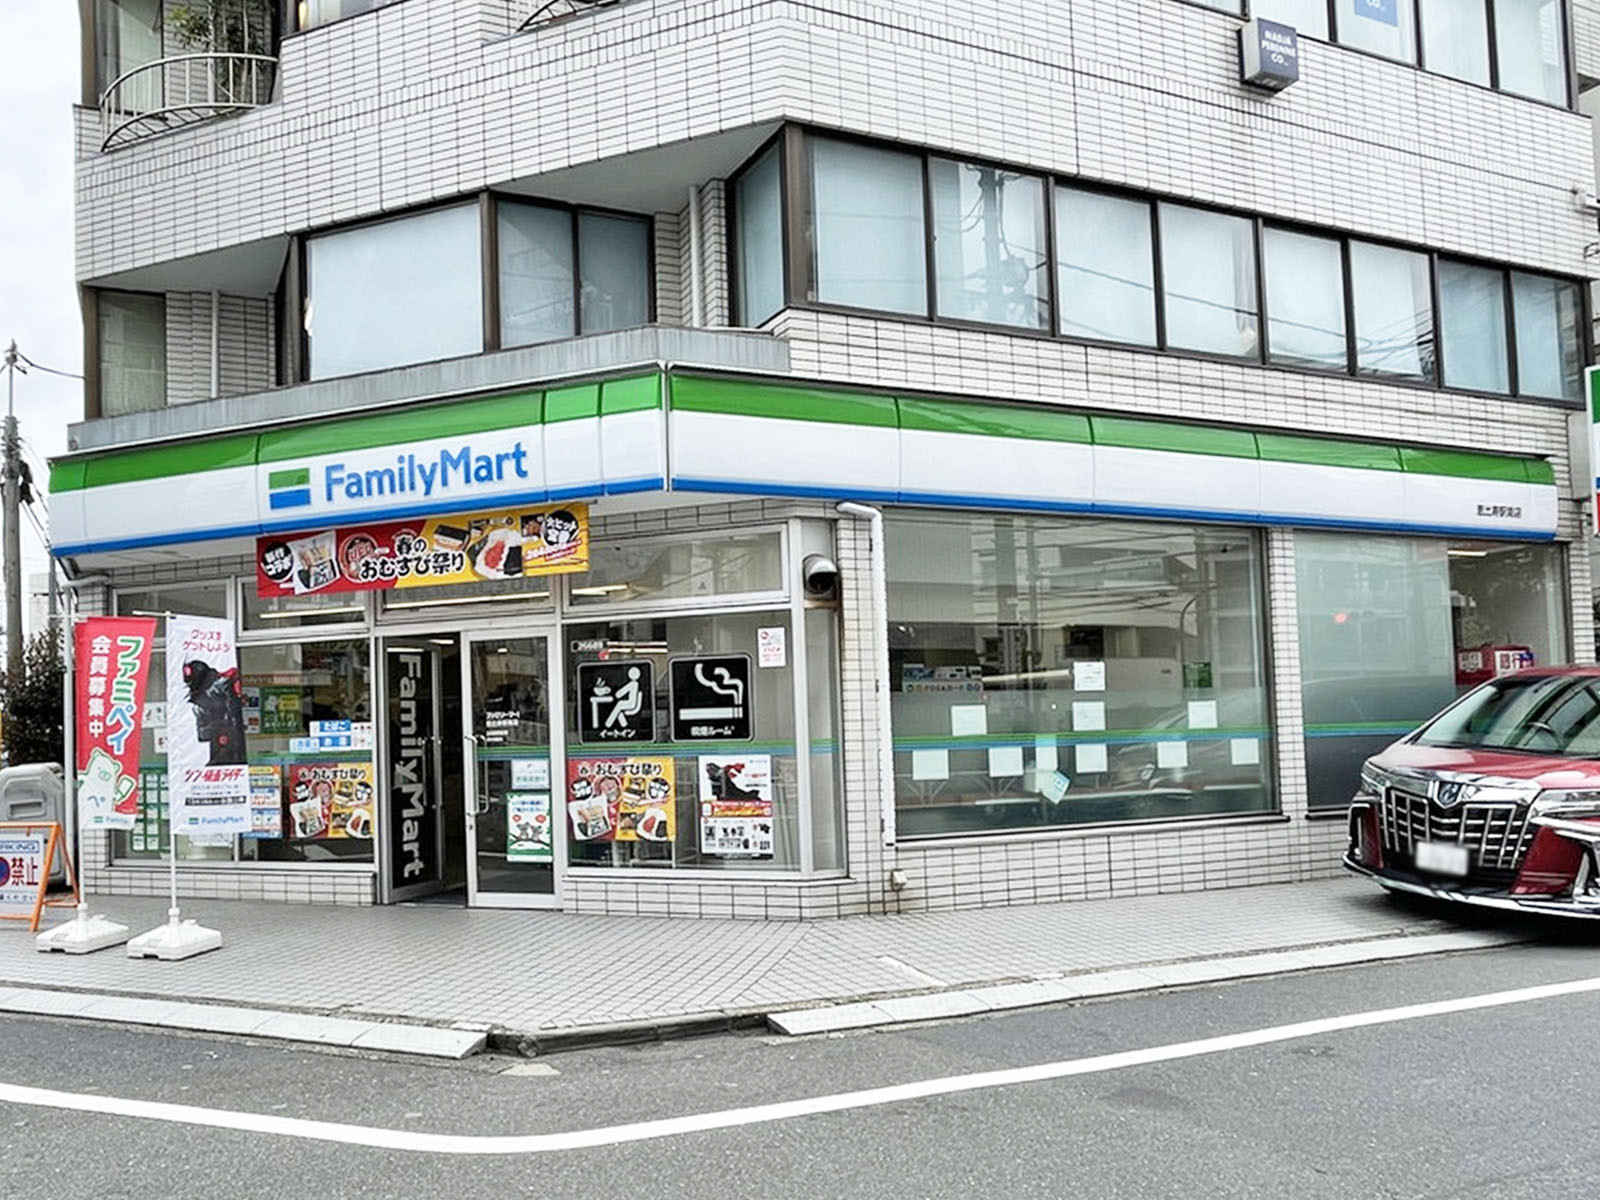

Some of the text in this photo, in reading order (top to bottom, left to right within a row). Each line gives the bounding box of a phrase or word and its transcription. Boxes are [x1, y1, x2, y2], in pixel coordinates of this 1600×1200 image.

[325, 441, 528, 501] FamilyMart
[360, 552, 465, 579] おむすび祭り
[397, 536, 427, 556] 春の
[88, 635, 111, 738] 会員募集中
[108, 637, 144, 754] ファミペイ
[600, 729, 636, 739] イートイン
[393, 654, 426, 878] FamilyMart
[11, 856, 39, 886] 禁止
